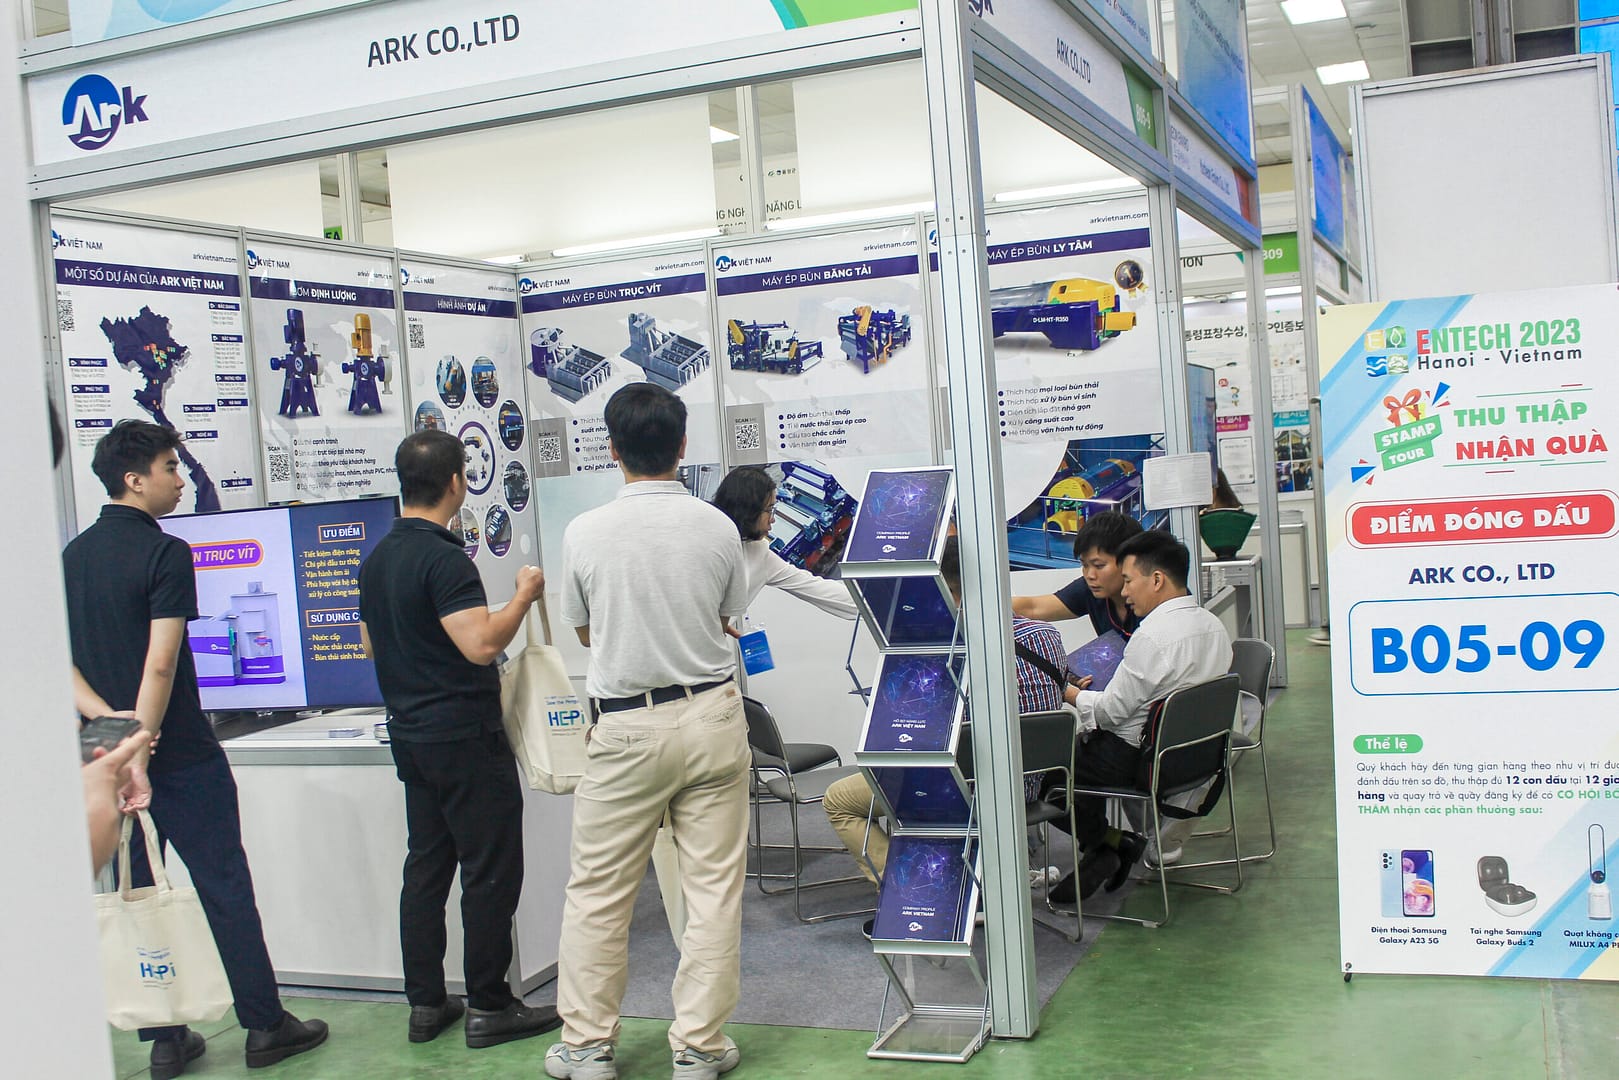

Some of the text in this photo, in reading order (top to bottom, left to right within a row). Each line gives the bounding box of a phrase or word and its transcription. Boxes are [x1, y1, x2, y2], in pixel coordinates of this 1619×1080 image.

[367, 14, 520, 68] ARK CO.,LTD
[1056, 37, 1069, 66] ARK
[63, 84, 149, 132] Ark
[1090, 212, 1149, 224] arkvietnam.com
[86, 241, 103, 250] NAM
[864, 240, 917, 251] arkvietnam.com
[1011, 247, 1024, 257] ÉP
[1053, 243, 1066, 253] LY
[1069, 240, 1092, 250] TÂM
[193, 253, 237, 263] arkvietnam.com
[277, 261, 290, 269] NAM
[655, 260, 705, 271] arkvietnam.com
[160, 277, 179, 287] ARK
[204, 280, 224, 290] NAM
[762, 276, 783, 286] MÁY
[785, 274, 797, 284] ÉP
[824, 268, 852, 279] BĂNG
[562, 294, 581, 304] MÁY
[583, 292, 595, 302] ÉP
[619, 288, 644, 299] TRỤC
[646, 283, 661, 294] VÍT
[1417, 318, 1581, 355] ENTECH 2023
[1418, 348, 1582, 370] Hanoi Vietnam
[1454, 399, 1587, 427] THU THẬP
[1381, 422, 1436, 446] STAMP
[1456, 429, 1608, 461] NHẬN QUÀ
[1388, 448, 1424, 465] TOUR
[1370, 502, 1590, 534] ĐIỂM ĐÓNG DẤU
[240, 546, 255, 559] VÍT
[1409, 563, 1555, 584] ARK CO., LTD
[1371, 620, 1605, 674] B05-09
[1366, 737, 1407, 752] Thể lệ
[1380, 762, 1406, 771] khách
[1478, 762, 1498, 773] gian
[1531, 761, 1551, 770] theo
[1452, 777, 1465, 785] thu
[1506, 776, 1520, 785] 12
[1523, 776, 1542, 785] con
[1586, 775, 1599, 784] 12
[1357, 790, 1385, 802] hàng
[1403, 792, 1425, 802] quay
[1519, 805, 1543, 814] sau:
[1412, 927, 1447, 935] Samsung
[1484, 929, 1503, 937] nghe
[1506, 928, 1542, 937] Samsung
[1379, 936, 1439, 945] Galaxy A23 5G
[1476, 938, 1505, 947] Galaxy
[1507, 938, 1526, 946] Buds
